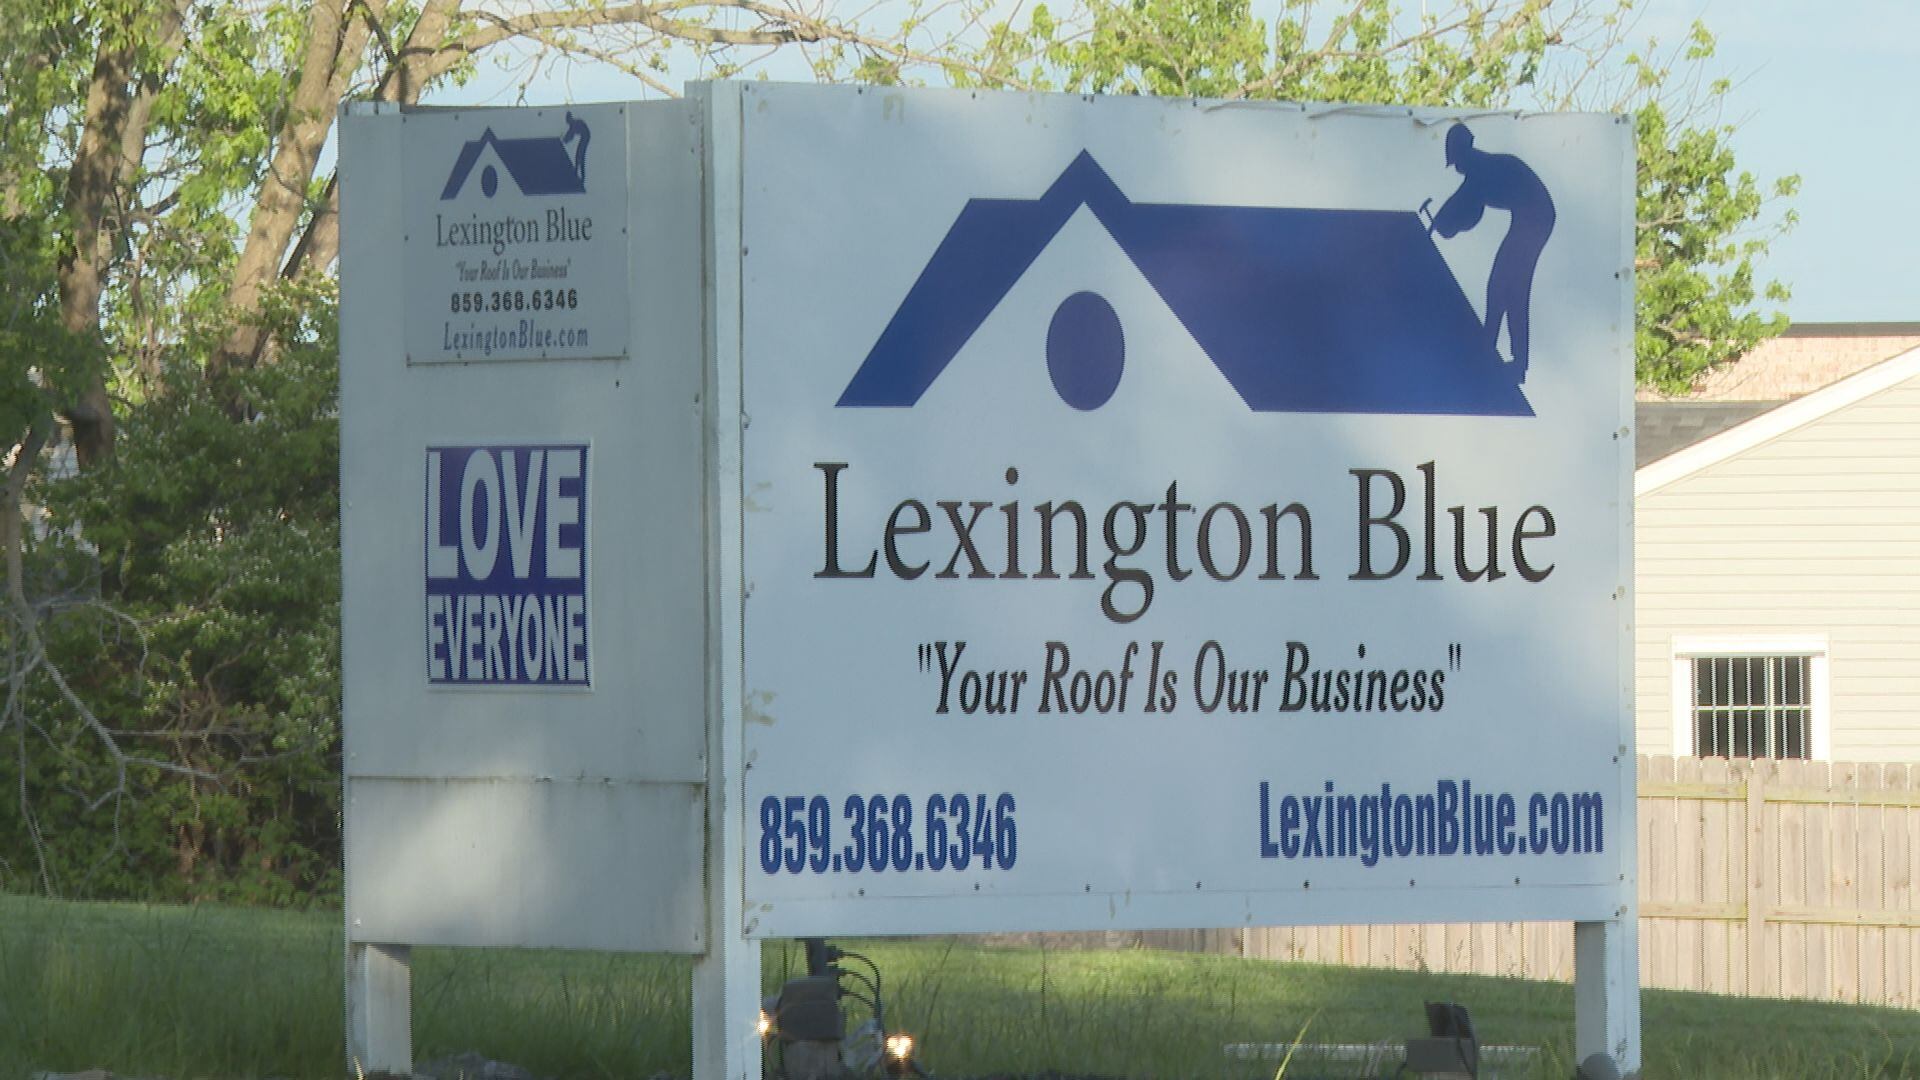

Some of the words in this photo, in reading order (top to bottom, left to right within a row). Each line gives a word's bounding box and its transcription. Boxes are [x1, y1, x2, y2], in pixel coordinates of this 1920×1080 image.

[436, 212, 540, 256] Lexington
[546, 206, 593, 244] Blue
[480, 259, 502, 281] Roof
[512, 258, 529, 280] Our
[443, 319, 589, 355] LexingtonBlue.com
[451, 289, 578, 312] 859.368.6346
[427, 449, 582, 581] LOVE
[813, 462, 1320, 624] Lexington
[1348, 460, 1557, 582] Blue
[428, 593, 586, 682] EVERYONE
[918, 641, 1027, 714] "Your
[1038, 641, 1139, 714] Roof
[1143, 641, 1178, 714] Is
[1193, 640, 1268, 713] Our
[1279, 641, 1462, 713] Business"
[759, 792, 1018, 875] 859.368.6346
[1259, 779, 1604, 868] LexingtonBlue.com
